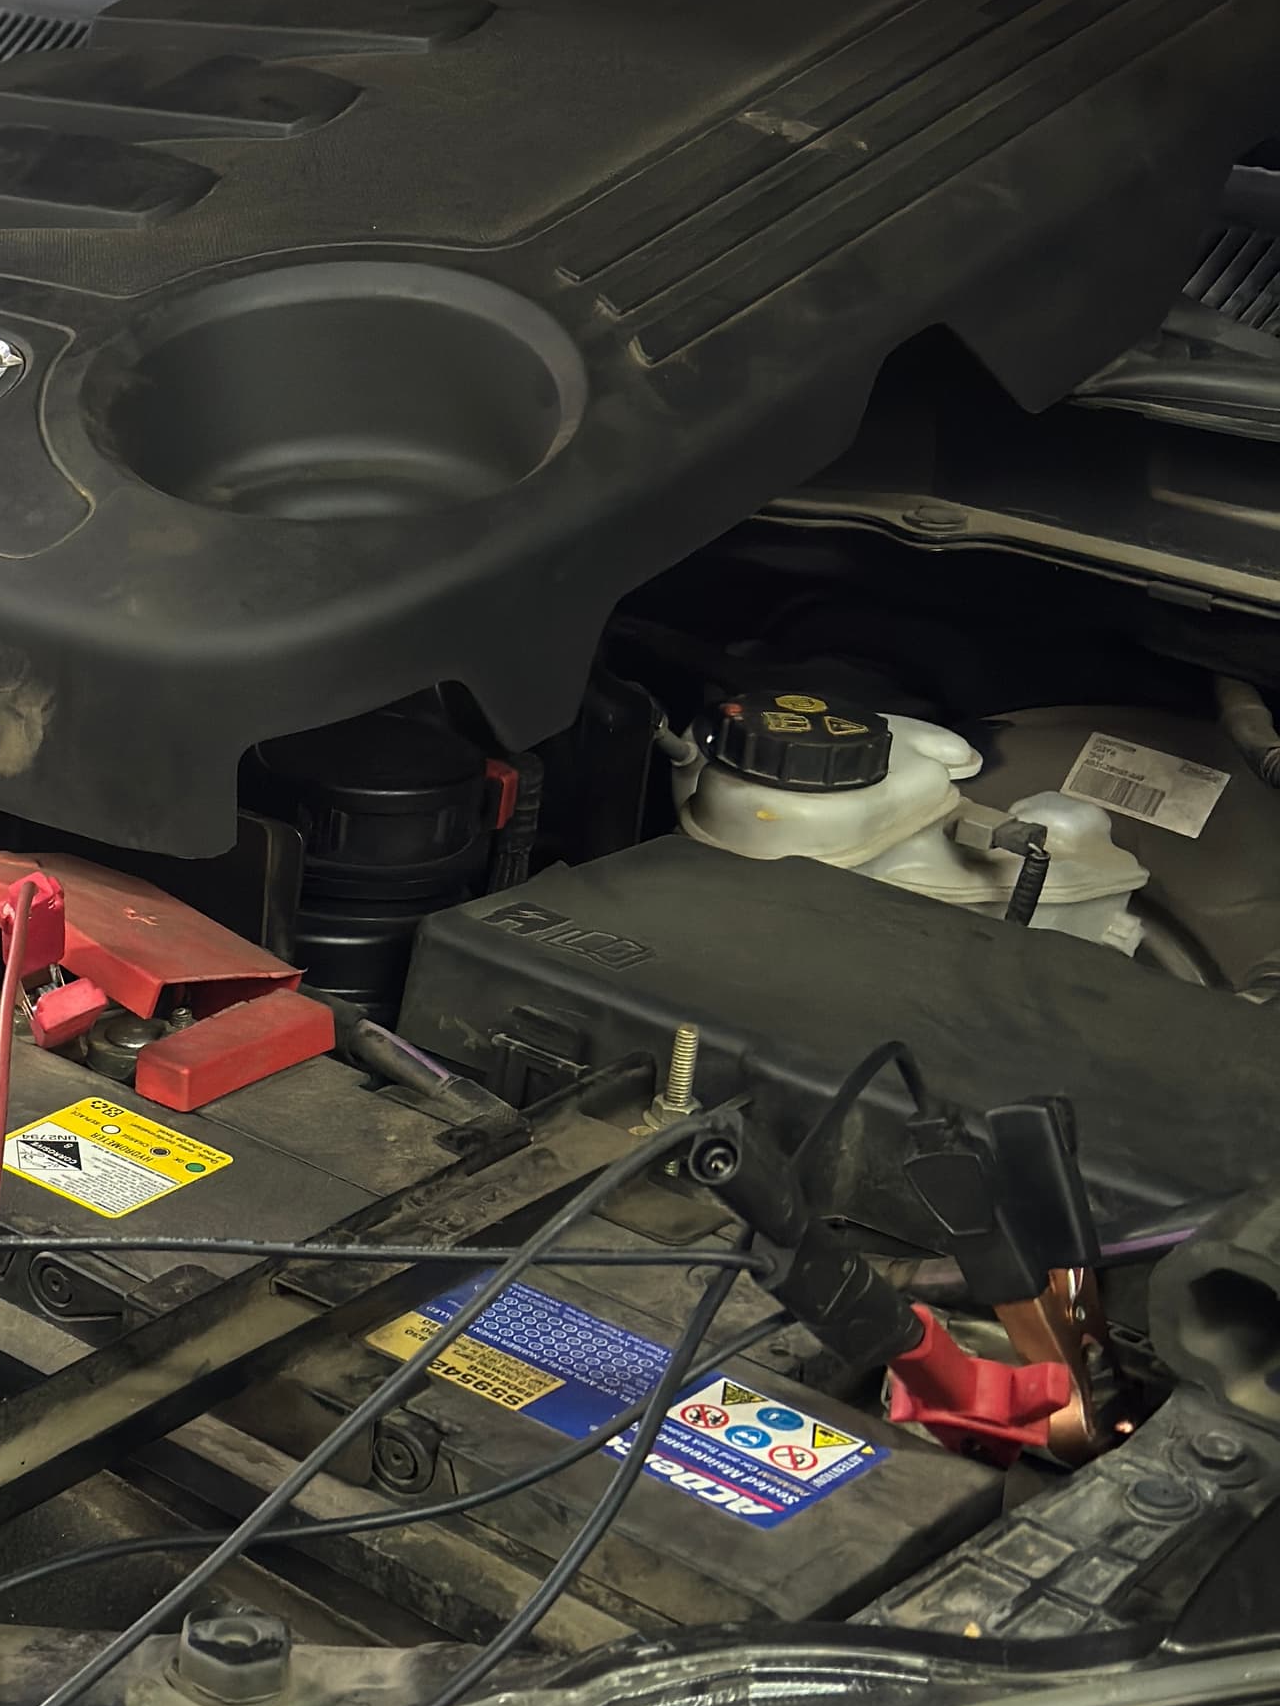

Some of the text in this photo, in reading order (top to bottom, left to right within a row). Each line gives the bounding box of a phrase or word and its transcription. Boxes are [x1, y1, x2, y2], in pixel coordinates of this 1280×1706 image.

[22, 1134, 78, 1142] UN2794
[26, 1141, 78, 1165] CORROSIVE
[90, 1132, 154, 1164] HYDROMETER
[425, 1358, 524, 1406] S59542
[656, 1433, 800, 1505] Sealed Maintenanc
